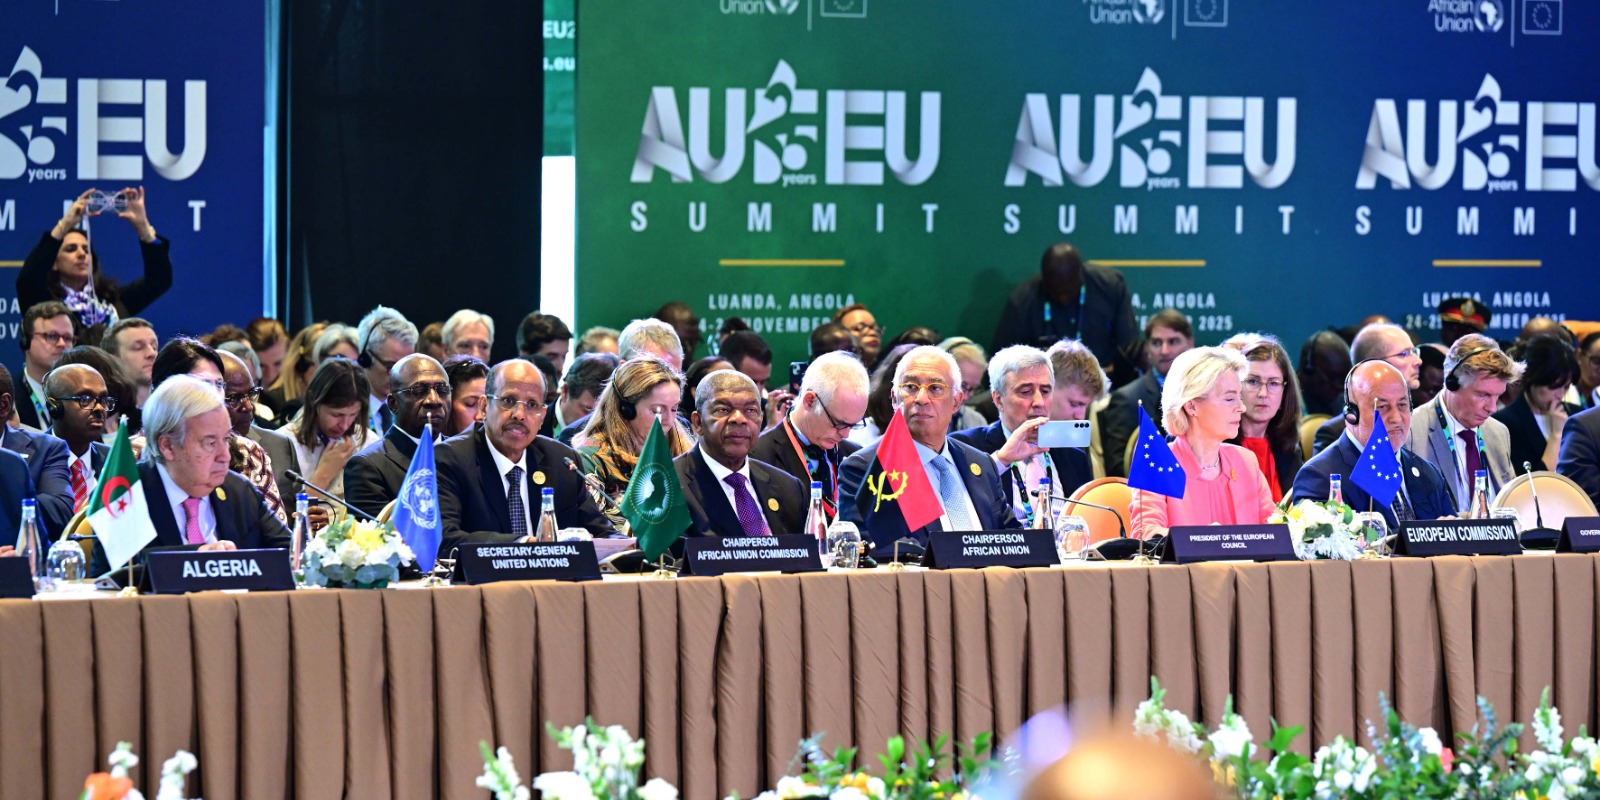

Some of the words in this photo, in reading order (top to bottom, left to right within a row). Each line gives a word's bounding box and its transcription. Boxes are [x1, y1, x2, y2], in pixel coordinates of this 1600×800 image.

[1090, 9, 1132, 24] Union
[1435, 15, 1474, 32] Union
[28, 168, 67, 183] years
[782, 172, 817, 187] years
[1147, 176, 1180, 191] years
[1488, 179, 1518, 194] years
[630, 202, 938, 233] SUMMIT
[1003, 204, 1295, 234] SUMMIT
[1355, 205, 1576, 236] SUMMI
[709, 293, 782, 311] LUANDA,
[789, 293, 855, 309] ANGOLA
[1153, 292, 1216, 309] ANGOLA
[1492, 291, 1551, 308] ANGOLA
[1198, 315, 1234, 331] 2025
[962, 534, 1025, 544] CHAIRPERSON
[1189, 534, 1221, 542] PRESIDENT
[1231, 533, 1243, 541] THE
[1243, 533, 1275, 541] EUROPEAN
[1406, 526, 1458, 543] EUROPEAN
[1457, 525, 1516, 542] COMMISSION
[722, 537, 779, 548] CHAIRPERSON
[476, 545, 580, 557] SECRETARY-GENERAL
[697, 550, 732, 561] AFRICAN
[733, 549, 758, 560] UNION
[759, 548, 809, 559] COMMISSION
[963, 546, 1001, 556] AFRICAN
[1002, 545, 1030, 555] UNION
[183, 559, 262, 578] ALGERIA
[492, 558, 527, 570] UNITED
[528, 557, 570, 568] NATIONS
